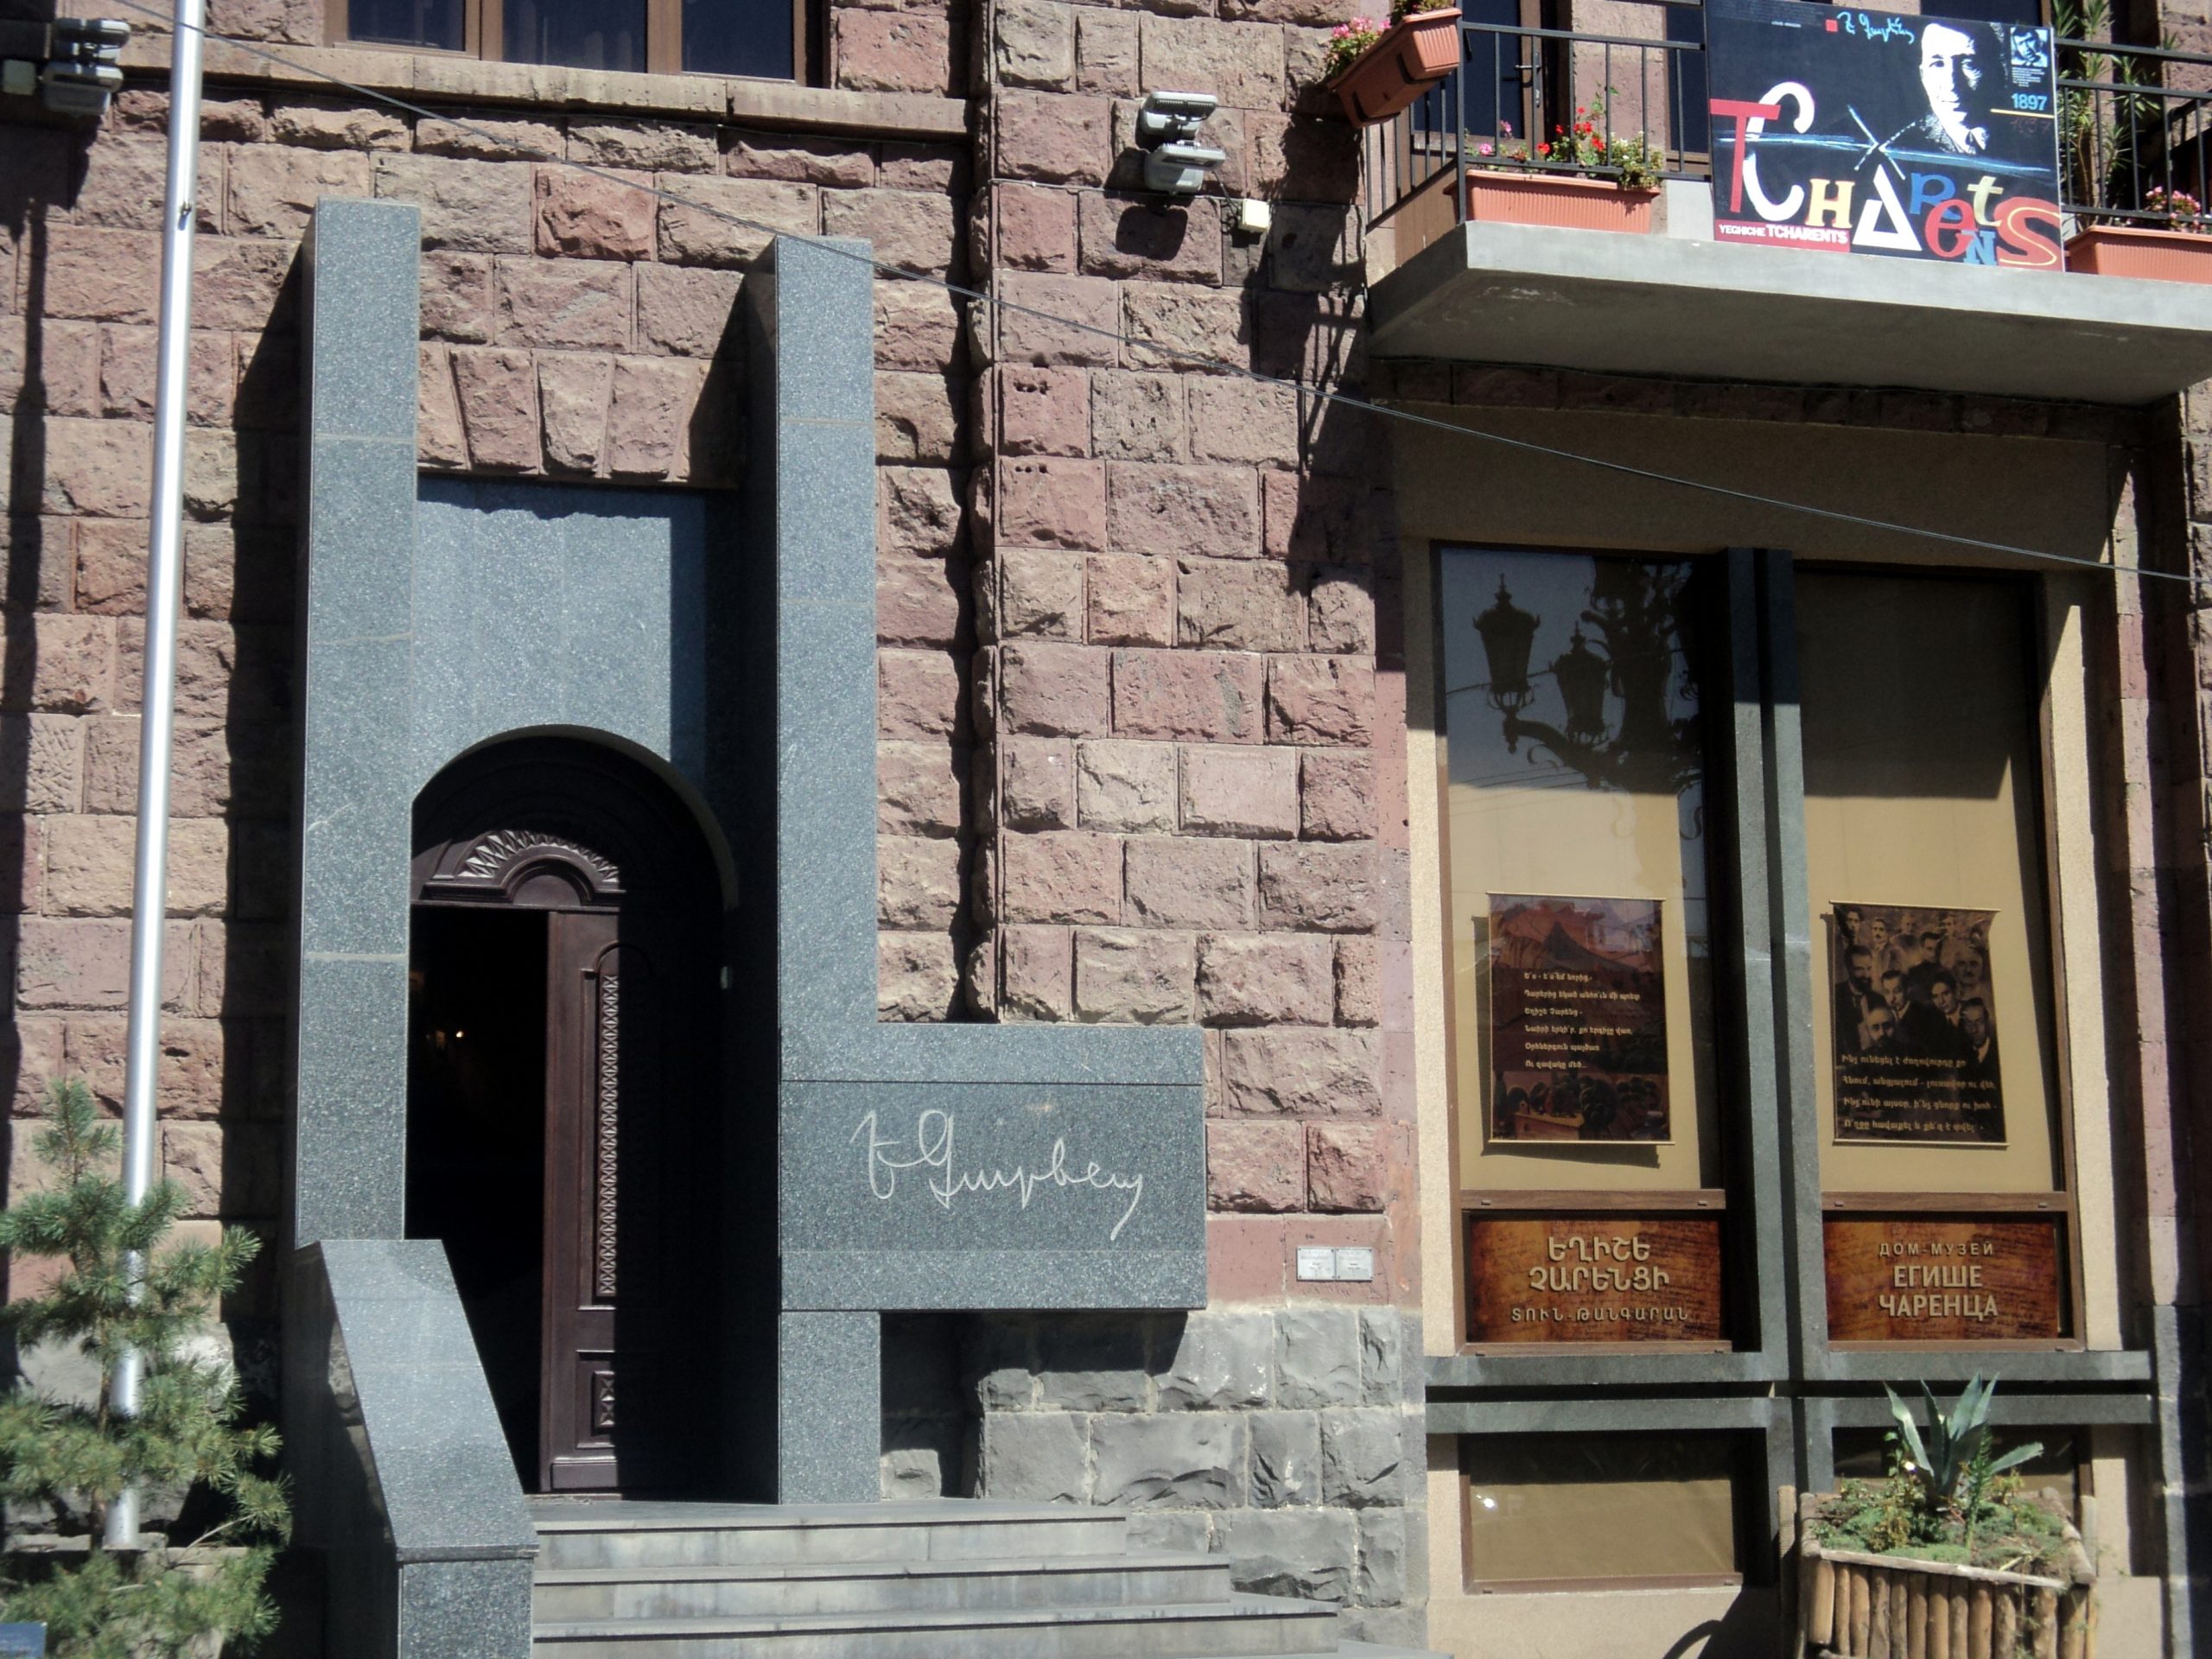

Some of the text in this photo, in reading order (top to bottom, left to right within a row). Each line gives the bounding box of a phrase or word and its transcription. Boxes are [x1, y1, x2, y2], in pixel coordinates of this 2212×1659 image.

[2011, 92, 2048, 111] 1897
[1719, 224, 1849, 245] YEGHICHE TCHARENTS
[1548, 1236, 1651, 1263] ԵՂԻՇԵ
[1529, 1265, 1669, 1292] ՉԱՐԵՆՑԻ
[1894, 1265, 1983, 1288] ЕГИШЕ
[1878, 1294, 1999, 1322] ЧАРЕНЦА
